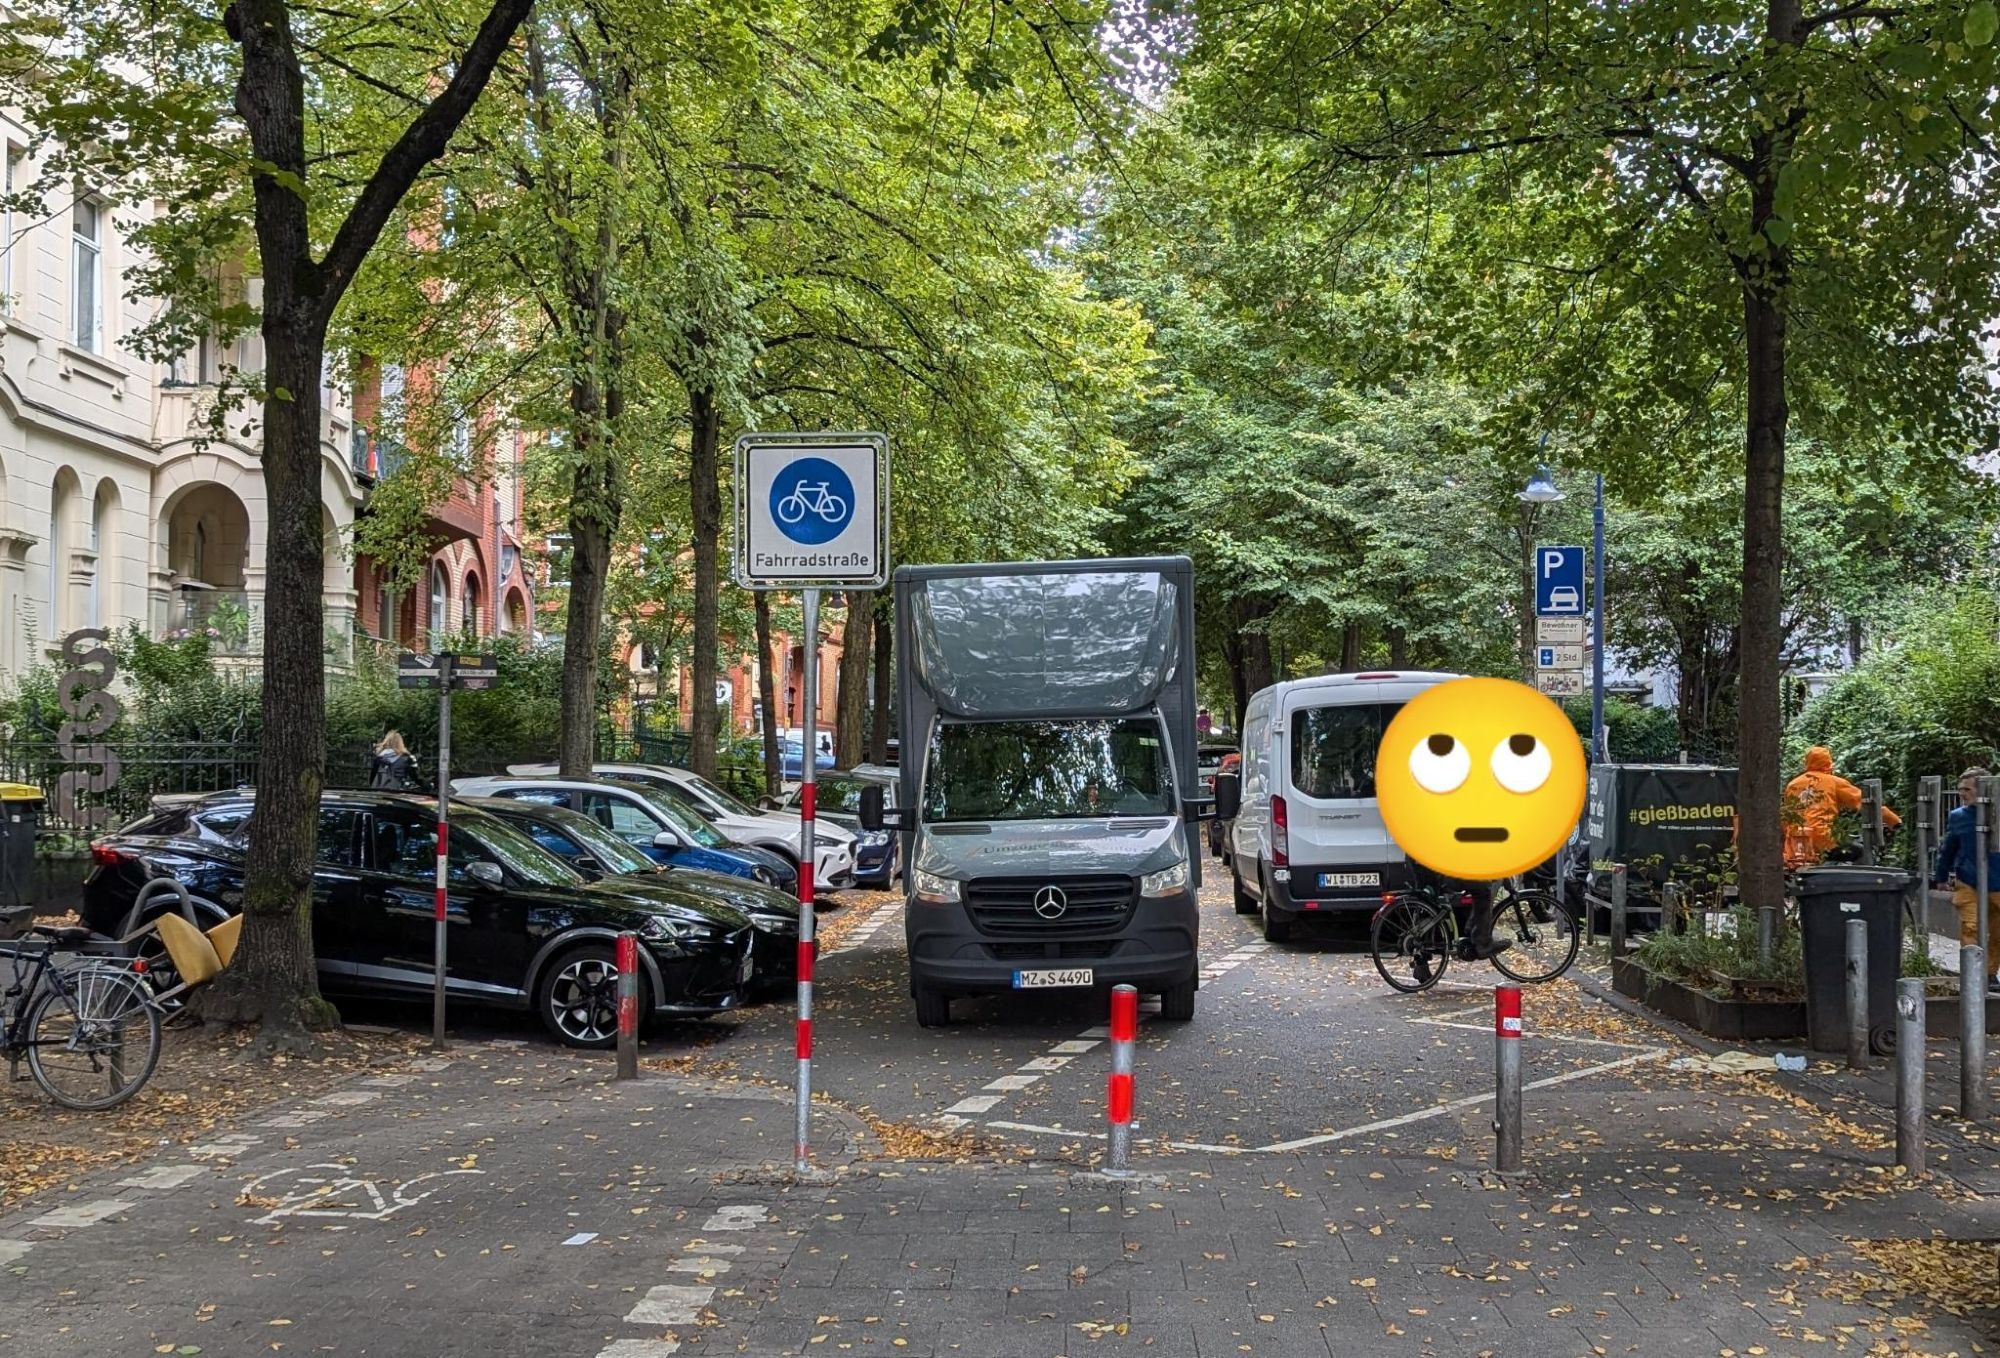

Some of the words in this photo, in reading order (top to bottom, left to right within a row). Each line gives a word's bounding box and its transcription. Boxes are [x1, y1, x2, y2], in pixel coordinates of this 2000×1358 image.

[755, 552, 870, 567] Fahrradstraße
[1544, 551, 1564, 578] P
[1541, 621, 1578, 629] Bewohner
[1556, 653, 1561, 662] 2
[1629, 803, 1734, 825] #gießbaden
[1326, 874, 1340, 885] WI
[1346, 874, 1358, 885] TB
[1359, 874, 1378, 885] 223
[1021, 972, 1039, 986] MZ
[1047, 971, 1056, 985] S
[1058, 970, 1092, 985] 4490
